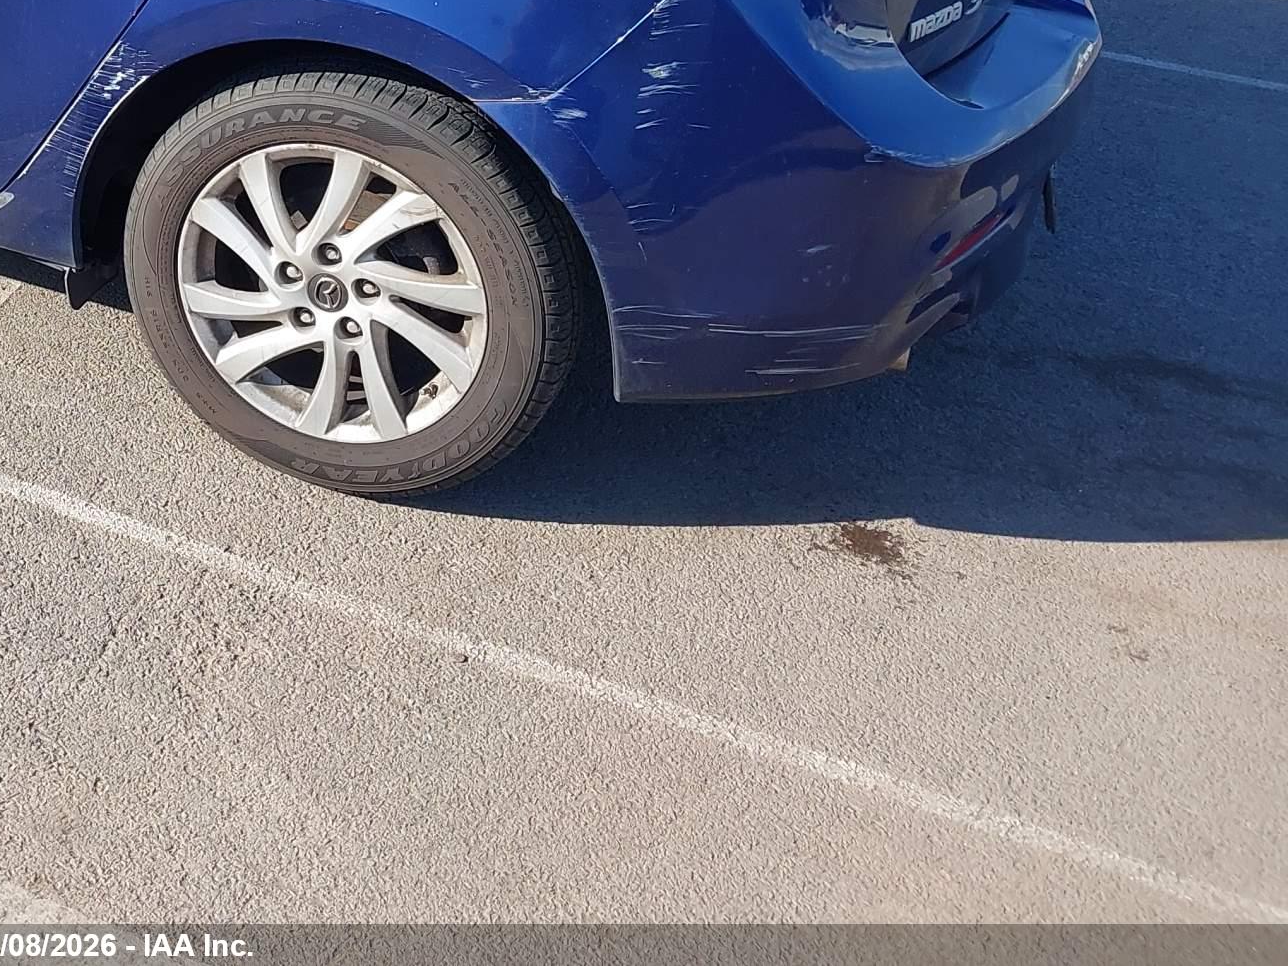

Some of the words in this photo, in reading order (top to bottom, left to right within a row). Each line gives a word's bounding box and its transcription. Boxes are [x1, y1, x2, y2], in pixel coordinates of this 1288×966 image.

[909, 0, 963, 43] mazda
[159, 107, 368, 212] ASSURANCE
[290, 400, 509, 484] GOODYEAR
